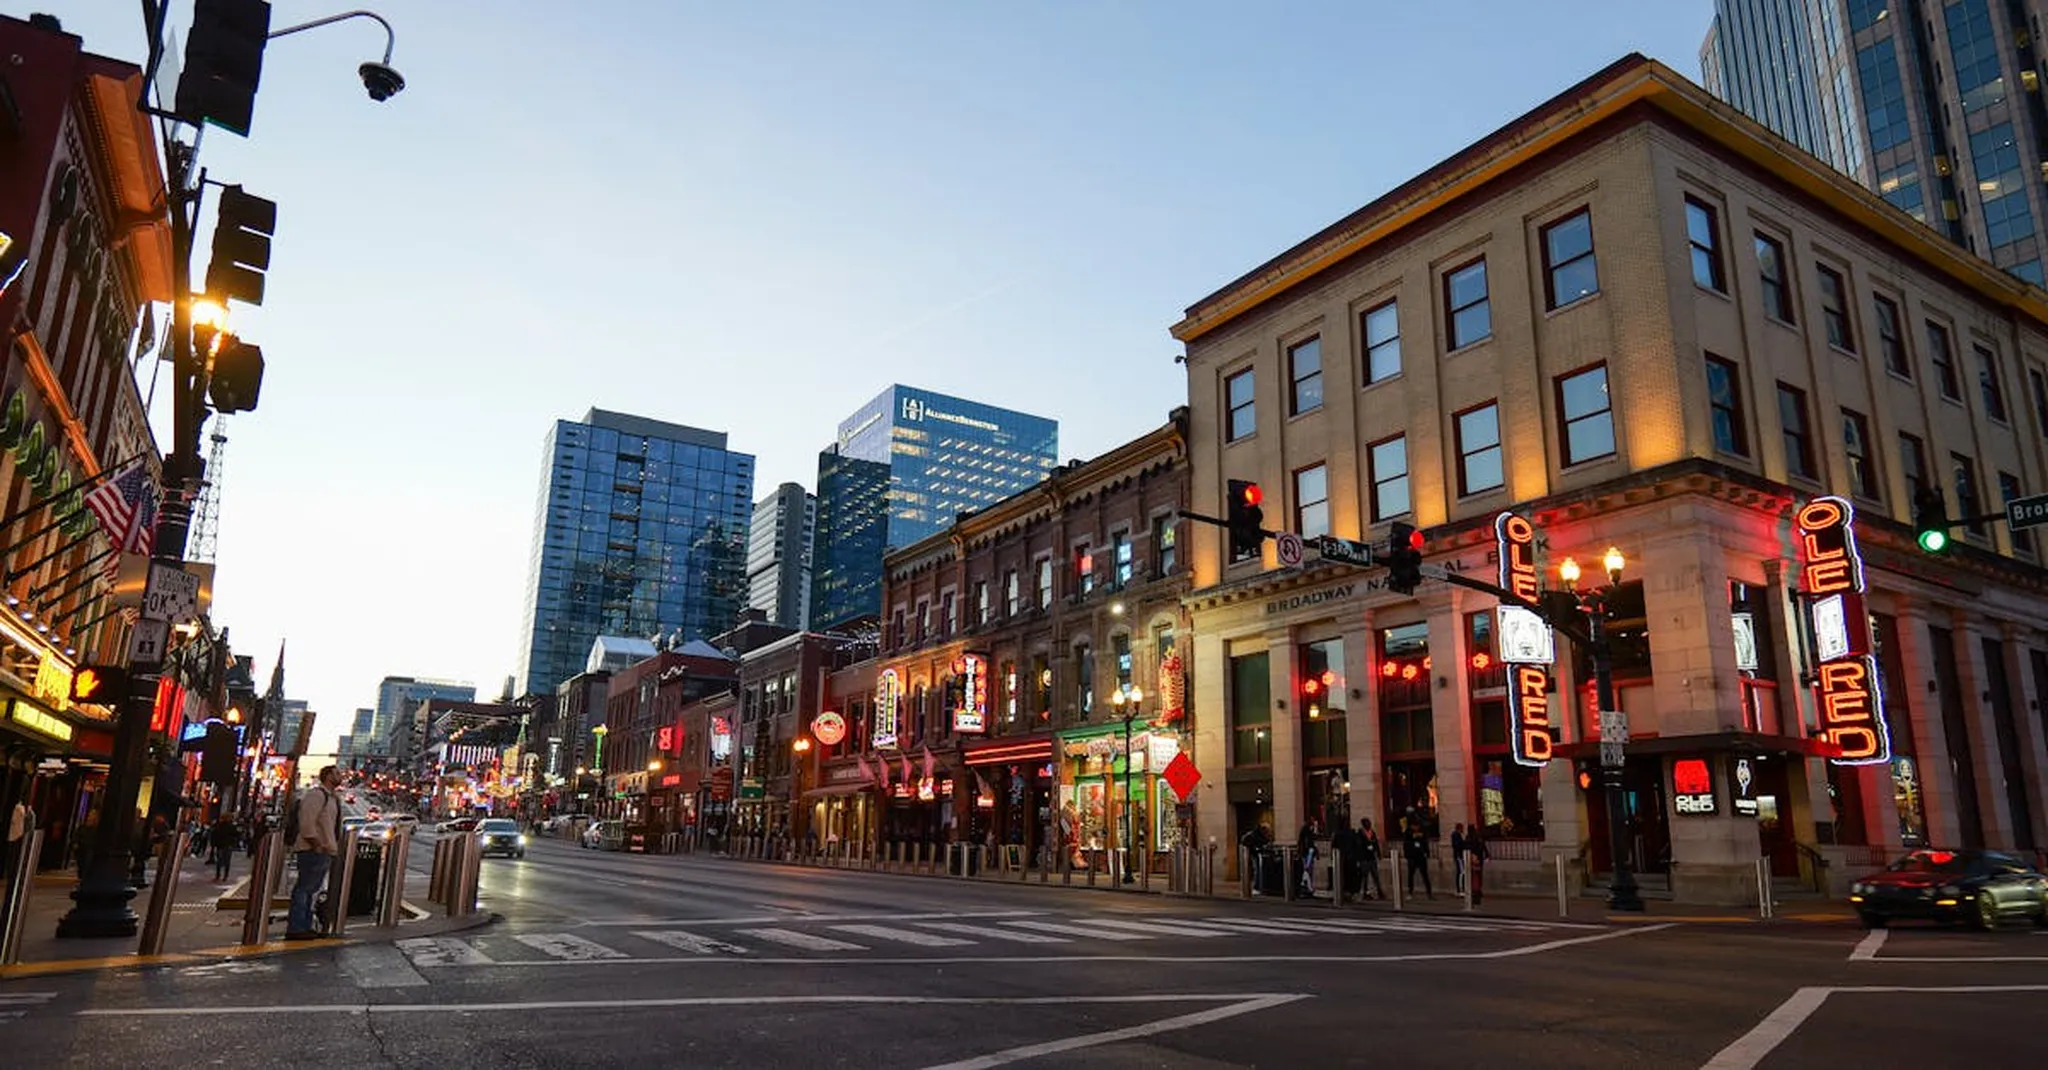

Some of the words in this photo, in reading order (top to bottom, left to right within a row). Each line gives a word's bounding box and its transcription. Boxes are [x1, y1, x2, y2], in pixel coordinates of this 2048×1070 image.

[1508, 516, 1539, 605] OLE
[1799, 502, 1850, 593] OLE
[149, 592, 168, 615] OK
[1267, 584, 1355, 613] BROADWAY
[1520, 667, 1551, 761] RED
[1820, 660, 1877, 758] RED
[1675, 794, 1713, 803] OLE
[1676, 802, 1714, 812] RED
